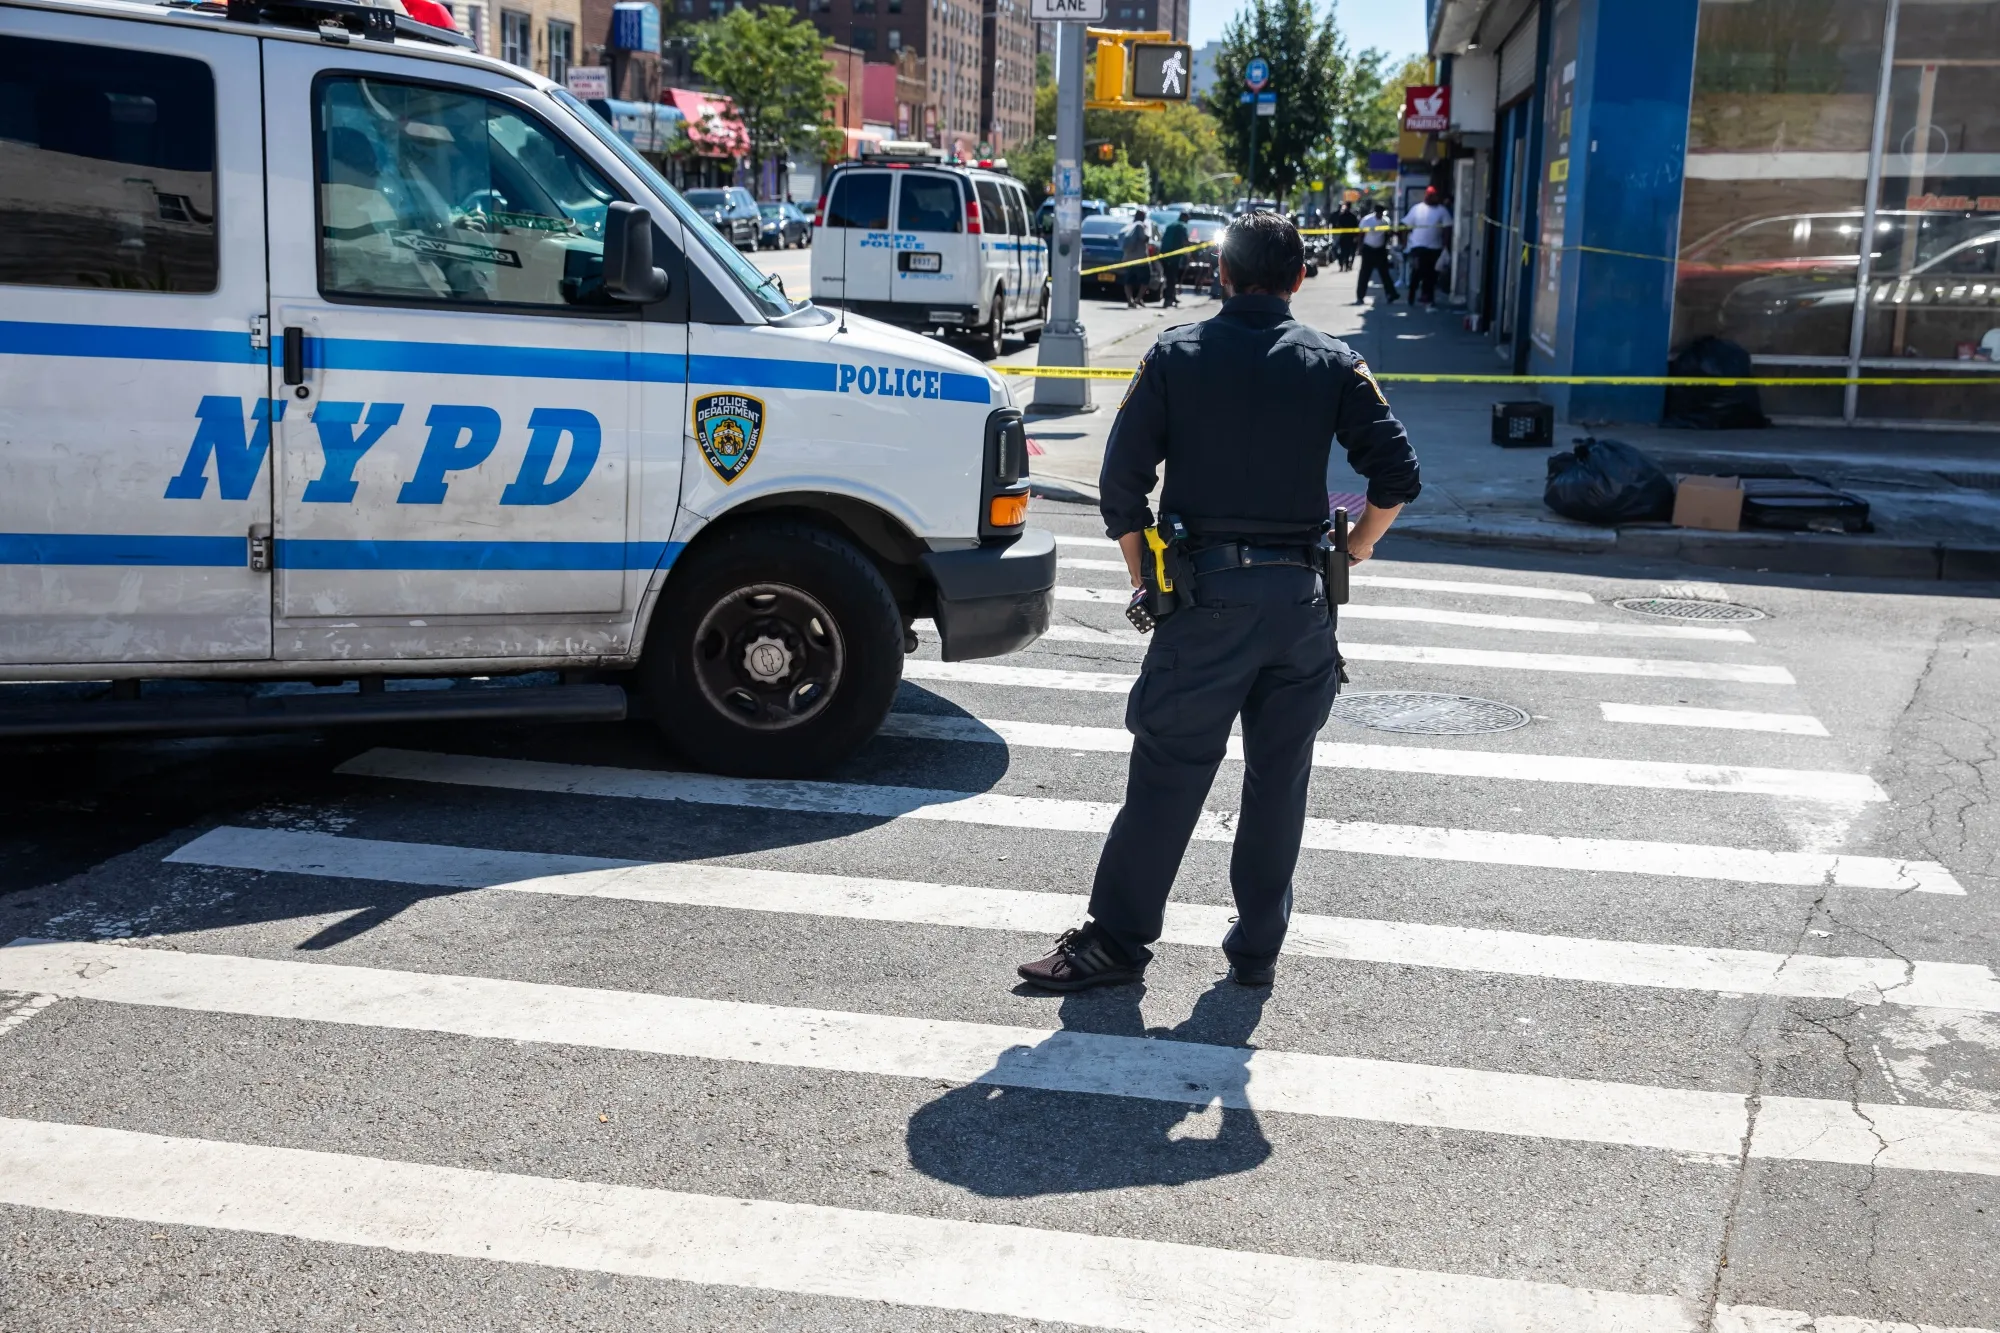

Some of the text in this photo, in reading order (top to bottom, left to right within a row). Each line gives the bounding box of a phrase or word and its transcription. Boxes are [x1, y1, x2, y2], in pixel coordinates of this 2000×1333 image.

[1046, 0, 1087, 11] LANE
[1406, 117, 1448, 129] PHARMACY
[867, 233, 917, 242] NYPD
[860, 240, 925, 250] POLICE
[838, 364, 940, 400] POLICE
[711, 396, 749, 409] POLICE
[698, 406, 760, 423] DEPARTMENT
[163, 395, 602, 505] NYPD
[698, 428, 760, 472] CITY OF NEW YORK
